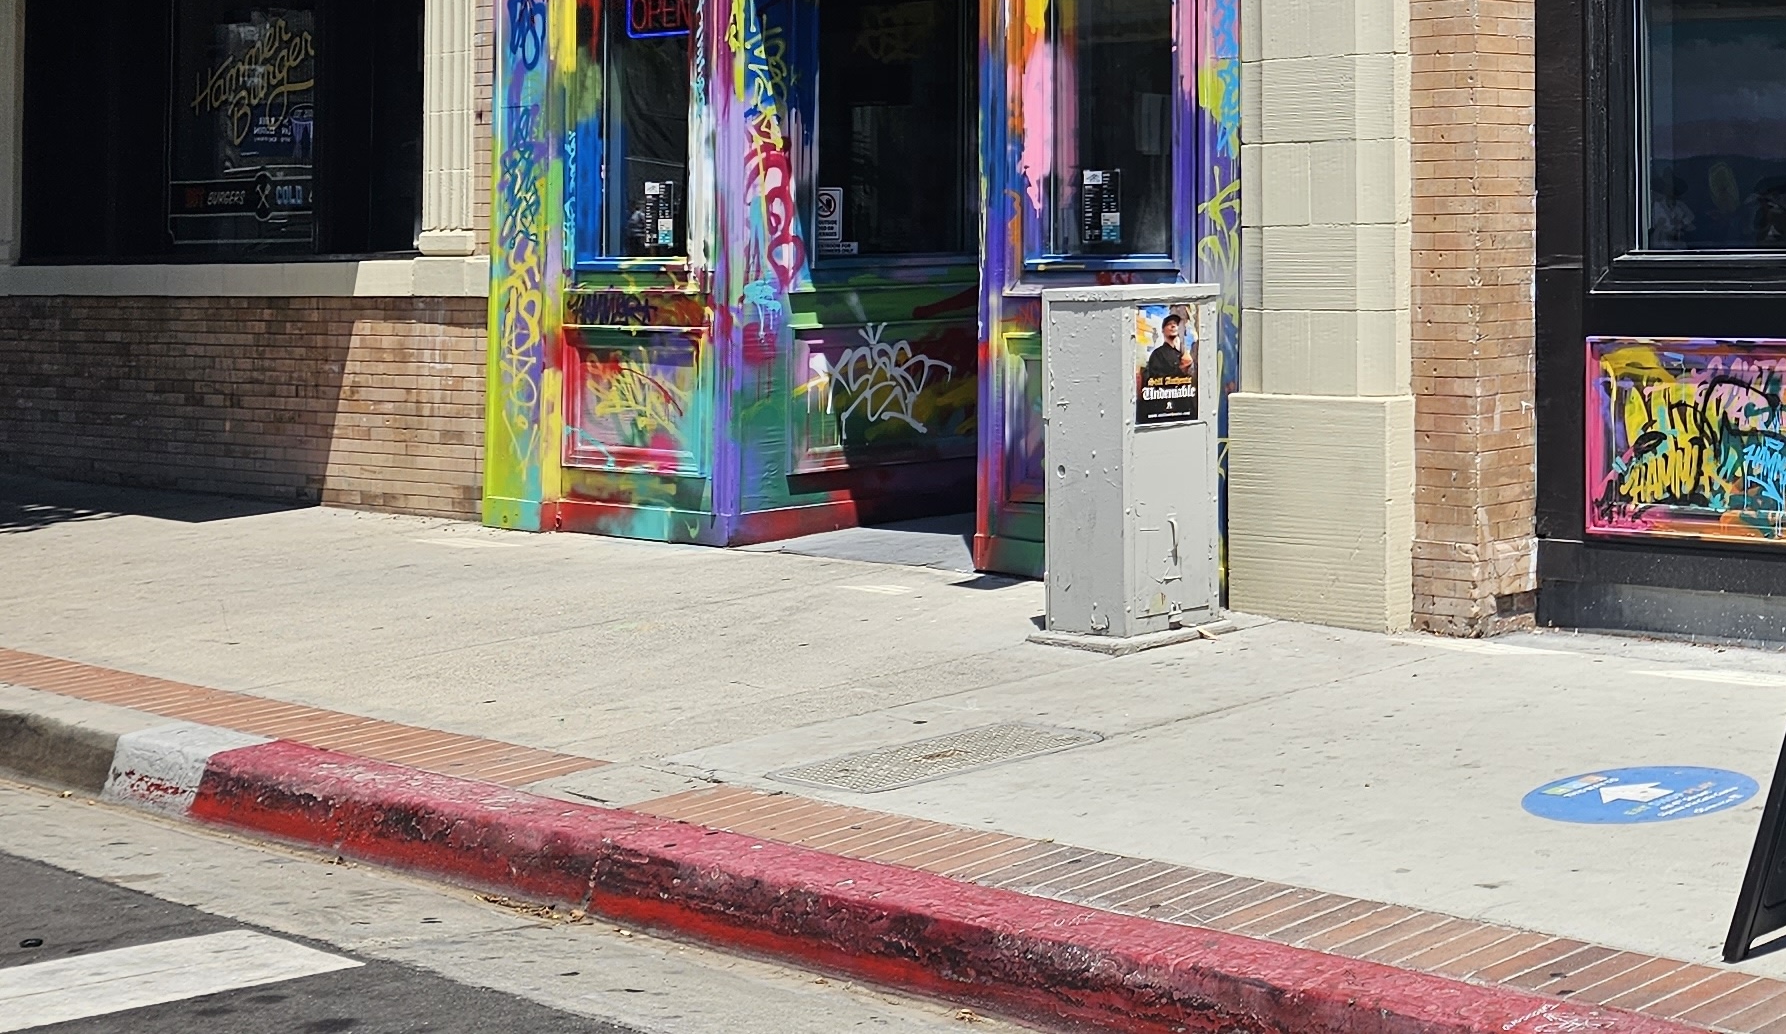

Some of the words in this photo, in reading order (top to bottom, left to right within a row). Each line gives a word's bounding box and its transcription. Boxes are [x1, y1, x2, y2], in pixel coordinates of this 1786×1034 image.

[190, 18, 292, 116] Hammer
[227, 30, 314, 146] Burger
[206, 189, 246, 206] BURGERS
[275, 184, 303, 206] COLD
